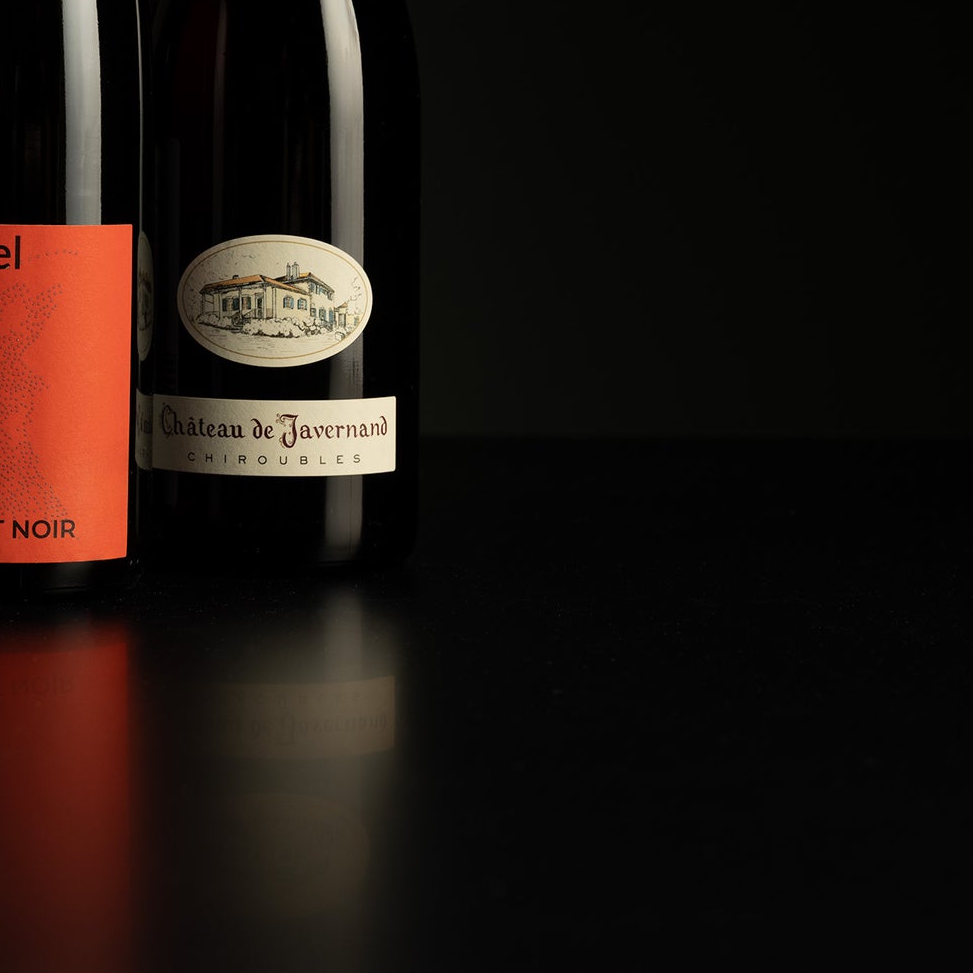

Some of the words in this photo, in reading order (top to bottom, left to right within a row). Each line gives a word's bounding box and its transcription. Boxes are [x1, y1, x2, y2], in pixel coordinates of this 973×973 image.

[161, 404, 244, 440] Château
[251, 418, 275, 439] de
[276, 413, 388, 449] Javernand
[187, 452, 362, 465] CHIROUBLES
[12, 519, 76, 539] NOIR
